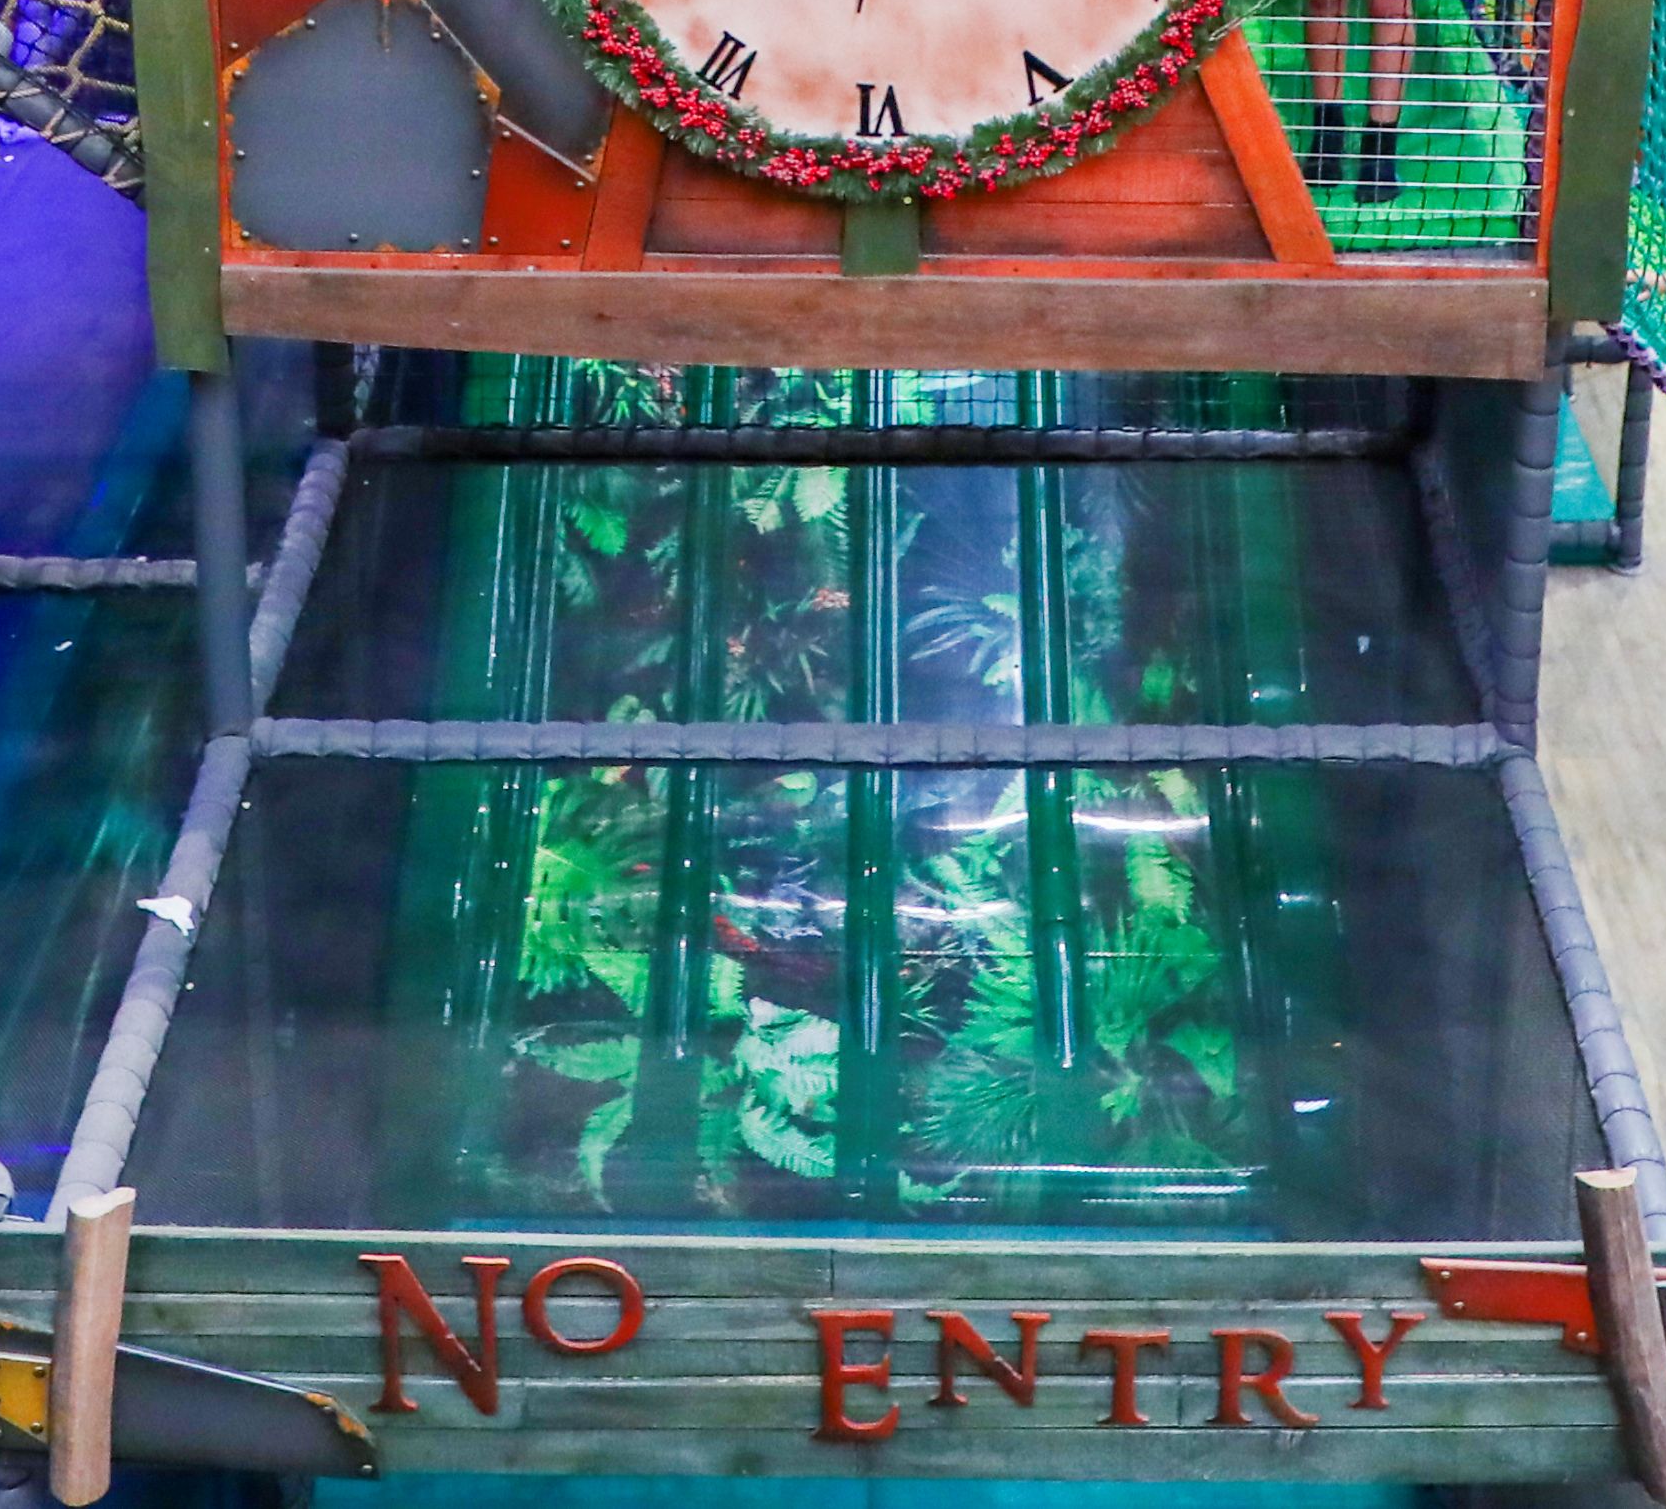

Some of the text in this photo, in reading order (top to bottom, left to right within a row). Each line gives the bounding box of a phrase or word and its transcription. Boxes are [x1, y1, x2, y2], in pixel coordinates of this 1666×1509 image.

[695, 31, 760, 101] VII
[1023, 50, 1074, 107] V
[856, 83, 905, 138] VI
[358, 1253, 1429, 1442] NO ENTRY
